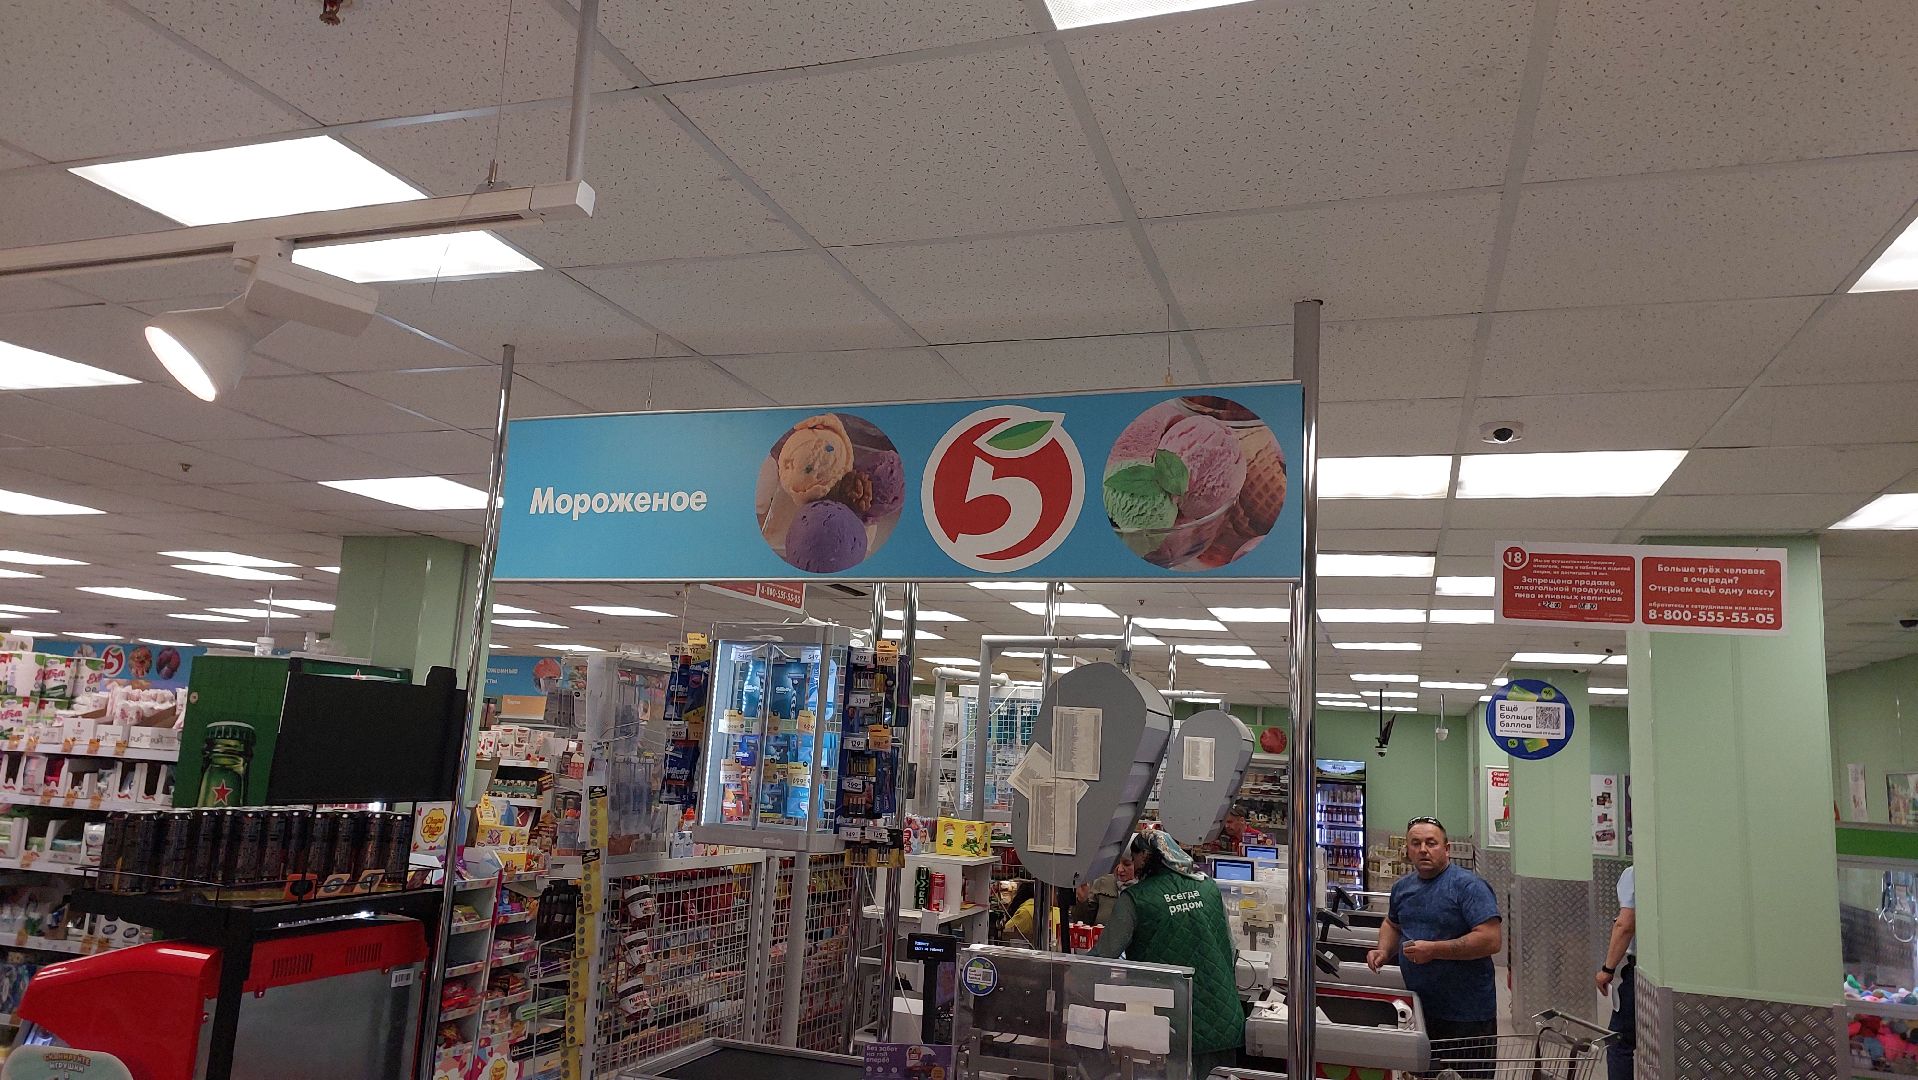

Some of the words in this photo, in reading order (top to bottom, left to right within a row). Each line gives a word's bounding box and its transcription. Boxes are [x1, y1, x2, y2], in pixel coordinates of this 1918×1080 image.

[529, 486, 708, 521] Мороженое
[1506, 551, 1523, 564] 18
[1657, 563, 1696, 573] Больше
[1697, 565, 1721, 575] трёх
[1723, 567, 1766, 575] человек
[1521, 576, 1573, 586] Запрещена
[1574, 578, 1616, 588] продажа
[1690, 577, 1739, 585] очереди?
[1513, 584, 1570, 593] алкогольной
[1571, 586, 1624, 596] продукции,
[1648, 584, 1693, 594] Откроем
[1695, 585, 1717, 595] ещё
[1718, 588, 1744, 597] одну
[1746, 589, 1775, 598] кассу
[1648, 609, 1775, 625] 8-800-555-55-05
[1499, 704, 1518, 713] Ещё
[1499, 712, 1533, 721] больше
[1499, 721, 1532, 729] баллов
[918, 867, 927, 905] DRIVE
[1163, 889, 1200, 903] Всегда
[1168, 900, 1204, 916] рядом
[49, 1062, 84, 1072] ИГРУШКИ
